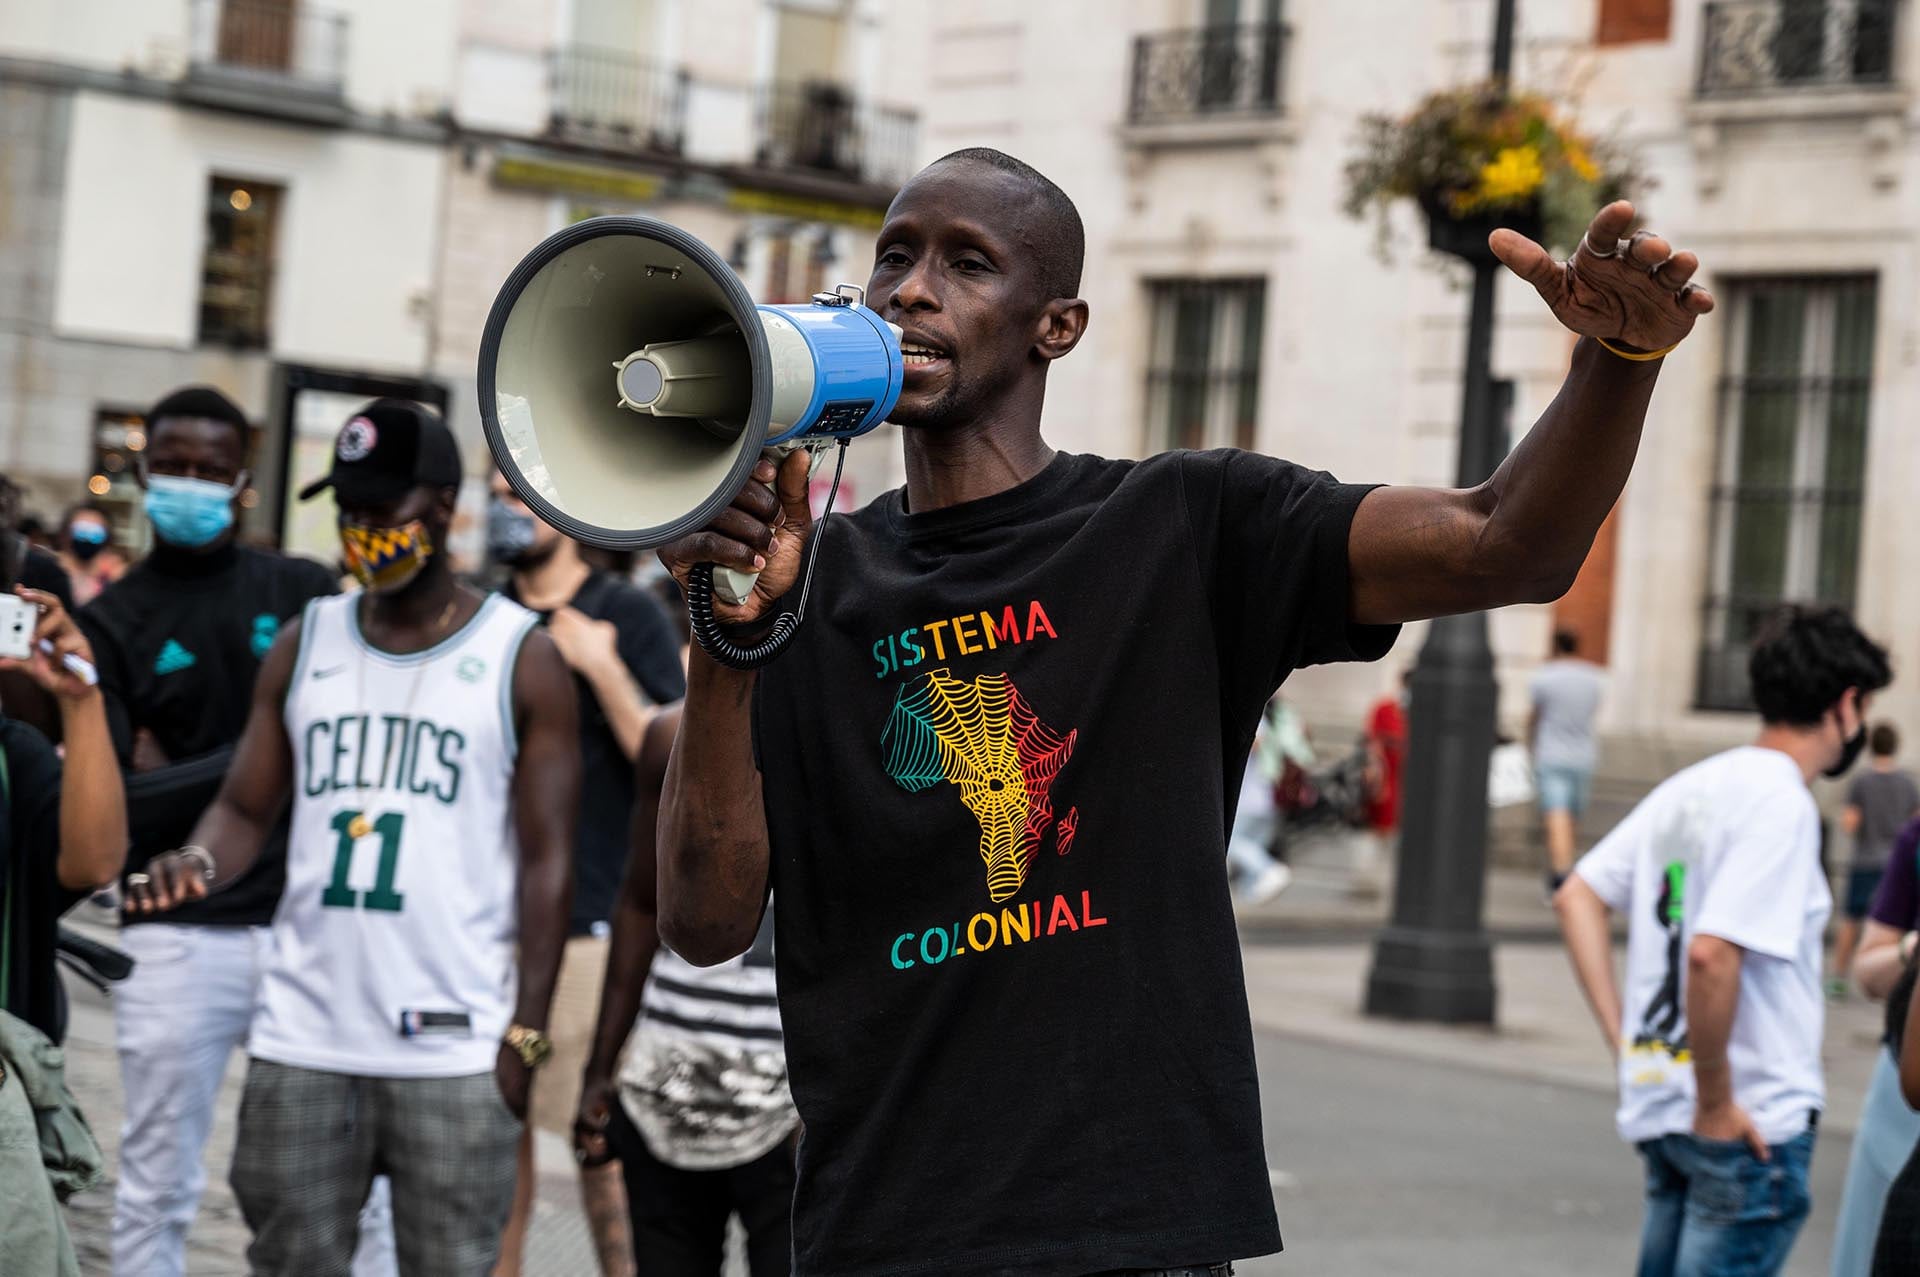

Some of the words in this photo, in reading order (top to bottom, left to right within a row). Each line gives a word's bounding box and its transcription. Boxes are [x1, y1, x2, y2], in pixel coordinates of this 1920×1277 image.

[873, 600, 1058, 679] SISTEMA
[305, 714, 465, 804] CELTICS
[321, 810, 405, 913] 11
[891, 890, 1108, 970] COLONIAL
